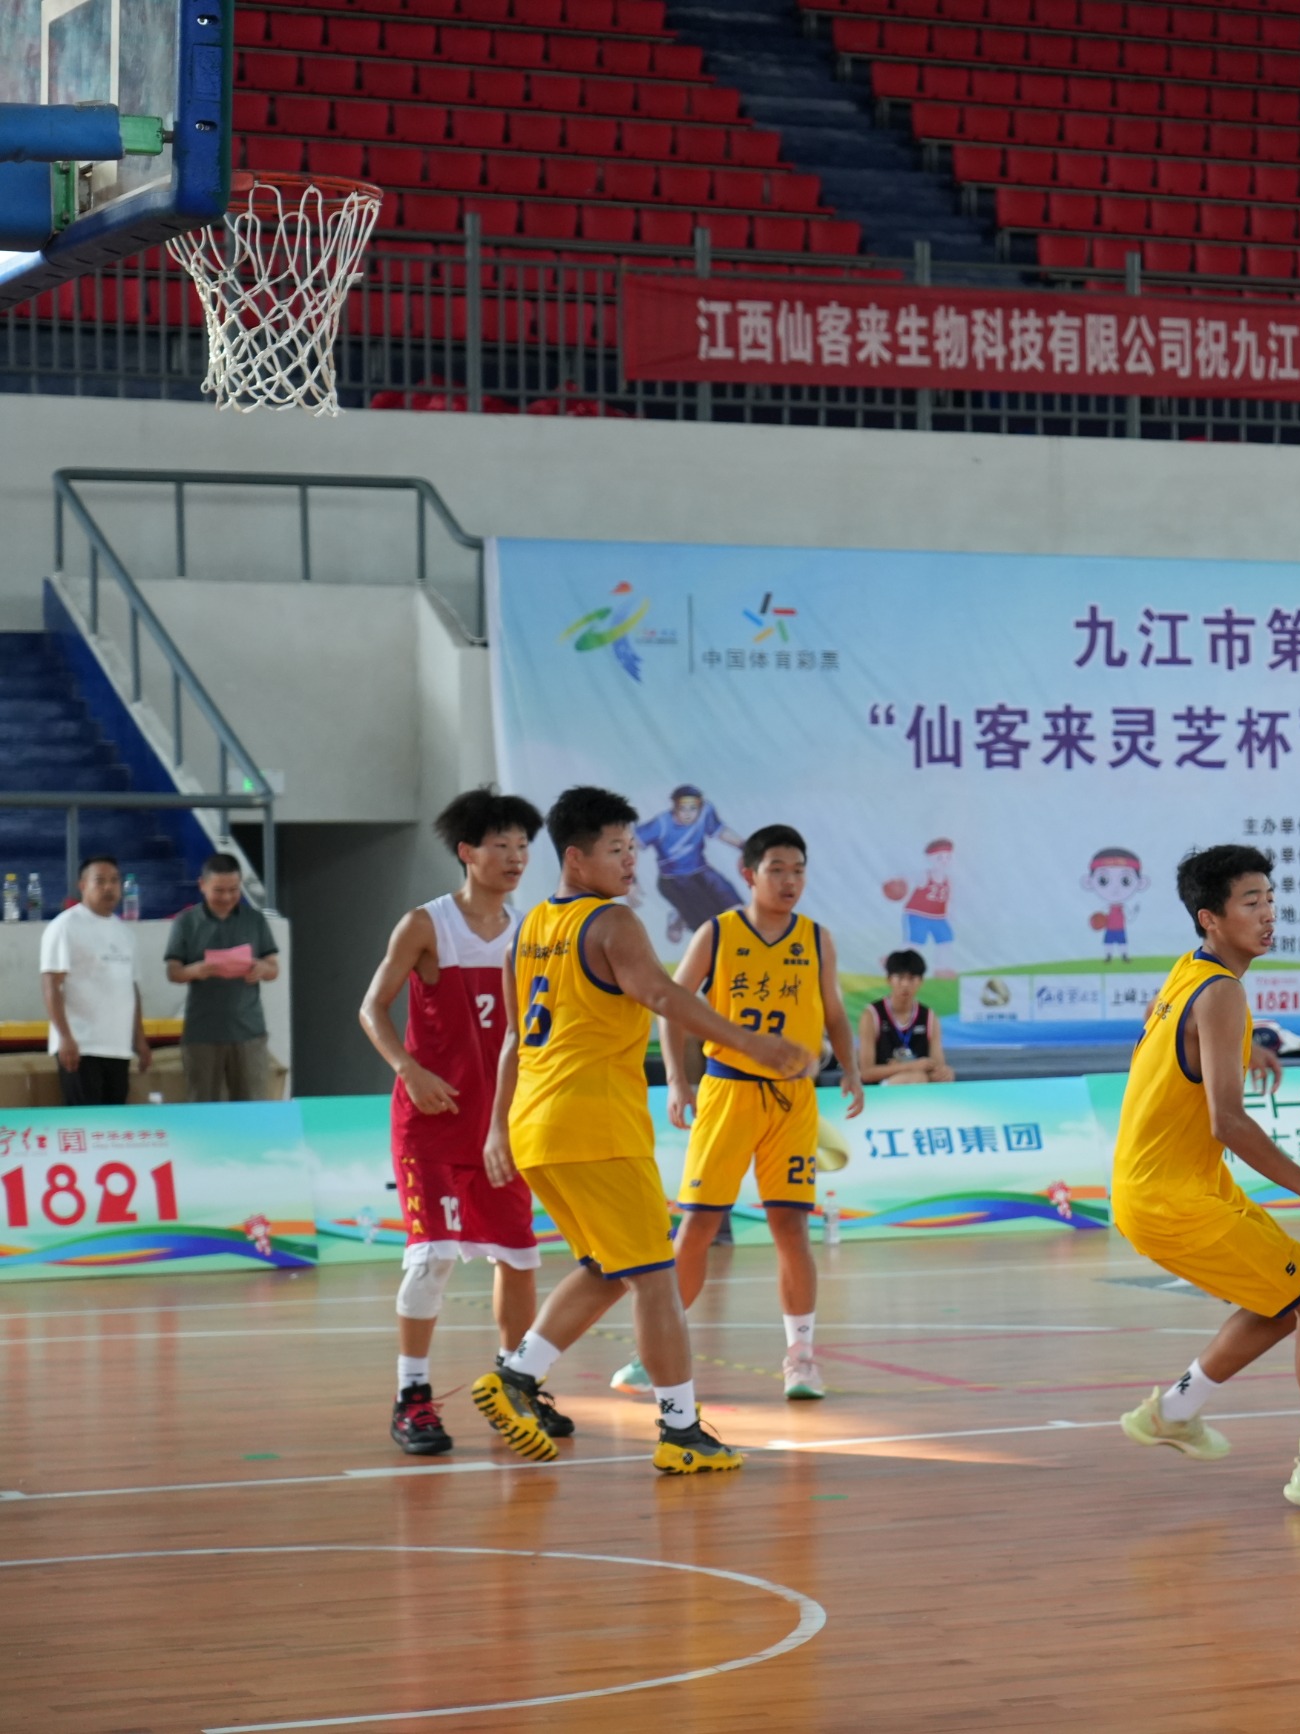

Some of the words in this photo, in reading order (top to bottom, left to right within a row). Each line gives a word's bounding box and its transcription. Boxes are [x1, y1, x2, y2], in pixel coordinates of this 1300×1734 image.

[865, 1122, 1044, 1158] 江铜集团
[787, 1155, 816, 1185] 23
[1, 1160, 178, 1227] 1821
[440, 1195, 463, 1232] 12
